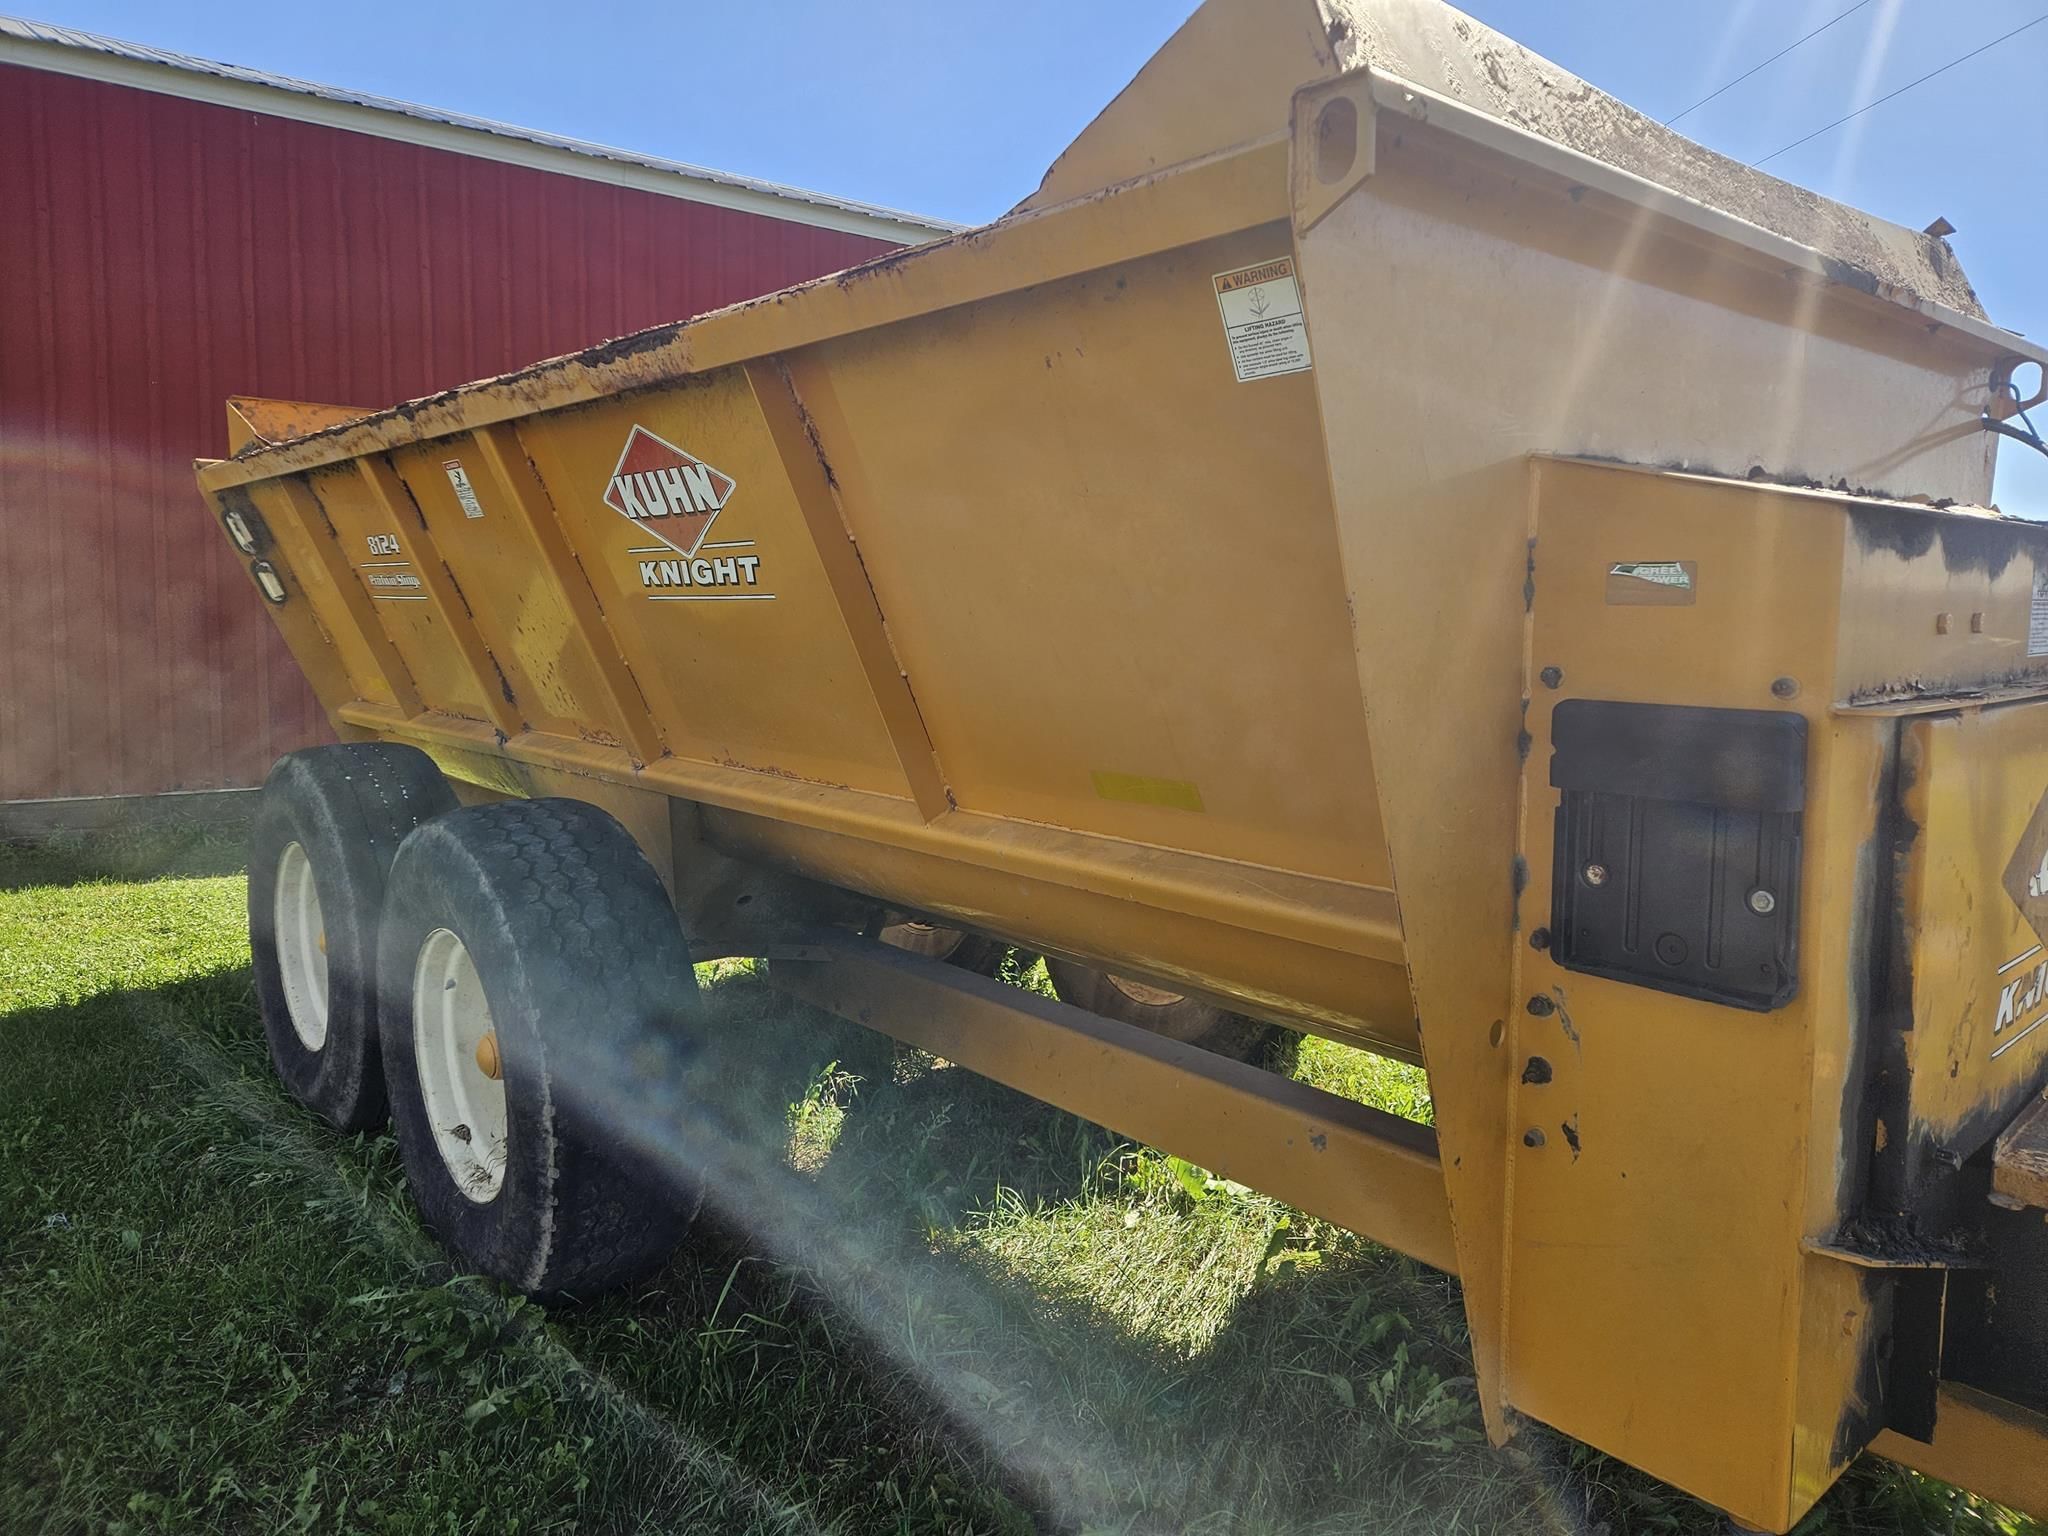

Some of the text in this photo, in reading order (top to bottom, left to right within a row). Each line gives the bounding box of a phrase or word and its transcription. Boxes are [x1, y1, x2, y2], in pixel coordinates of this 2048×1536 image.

[1233, 263, 1288, 287] WARNING
[613, 463, 721, 519] KUHN
[366, 534, 400, 555] 8124
[640, 556, 760, 586] KNIGHT
